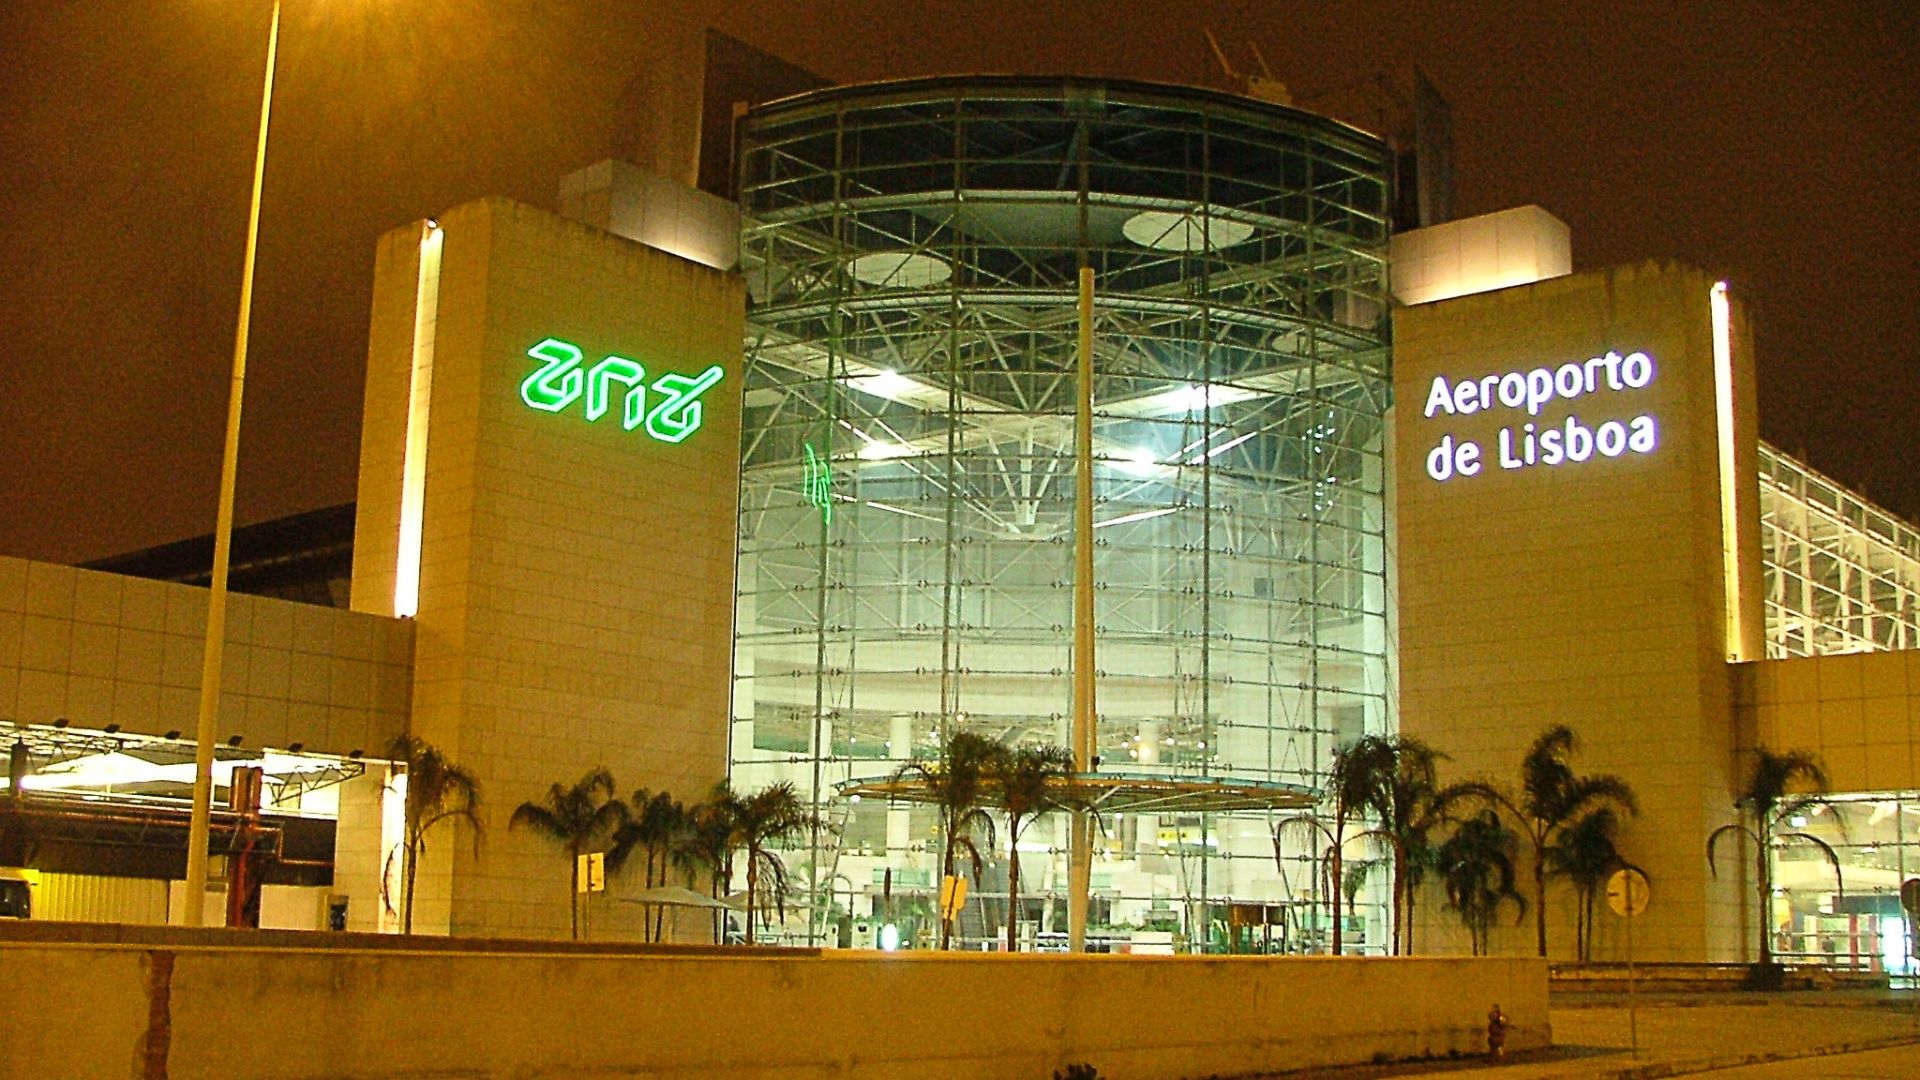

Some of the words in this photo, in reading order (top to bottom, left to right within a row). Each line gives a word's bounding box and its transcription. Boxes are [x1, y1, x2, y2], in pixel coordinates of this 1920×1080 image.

[1424, 351, 1653, 418] Aeroporto
[1426, 434, 1482, 481] de
[1498, 415, 1656, 469] Lisboa
